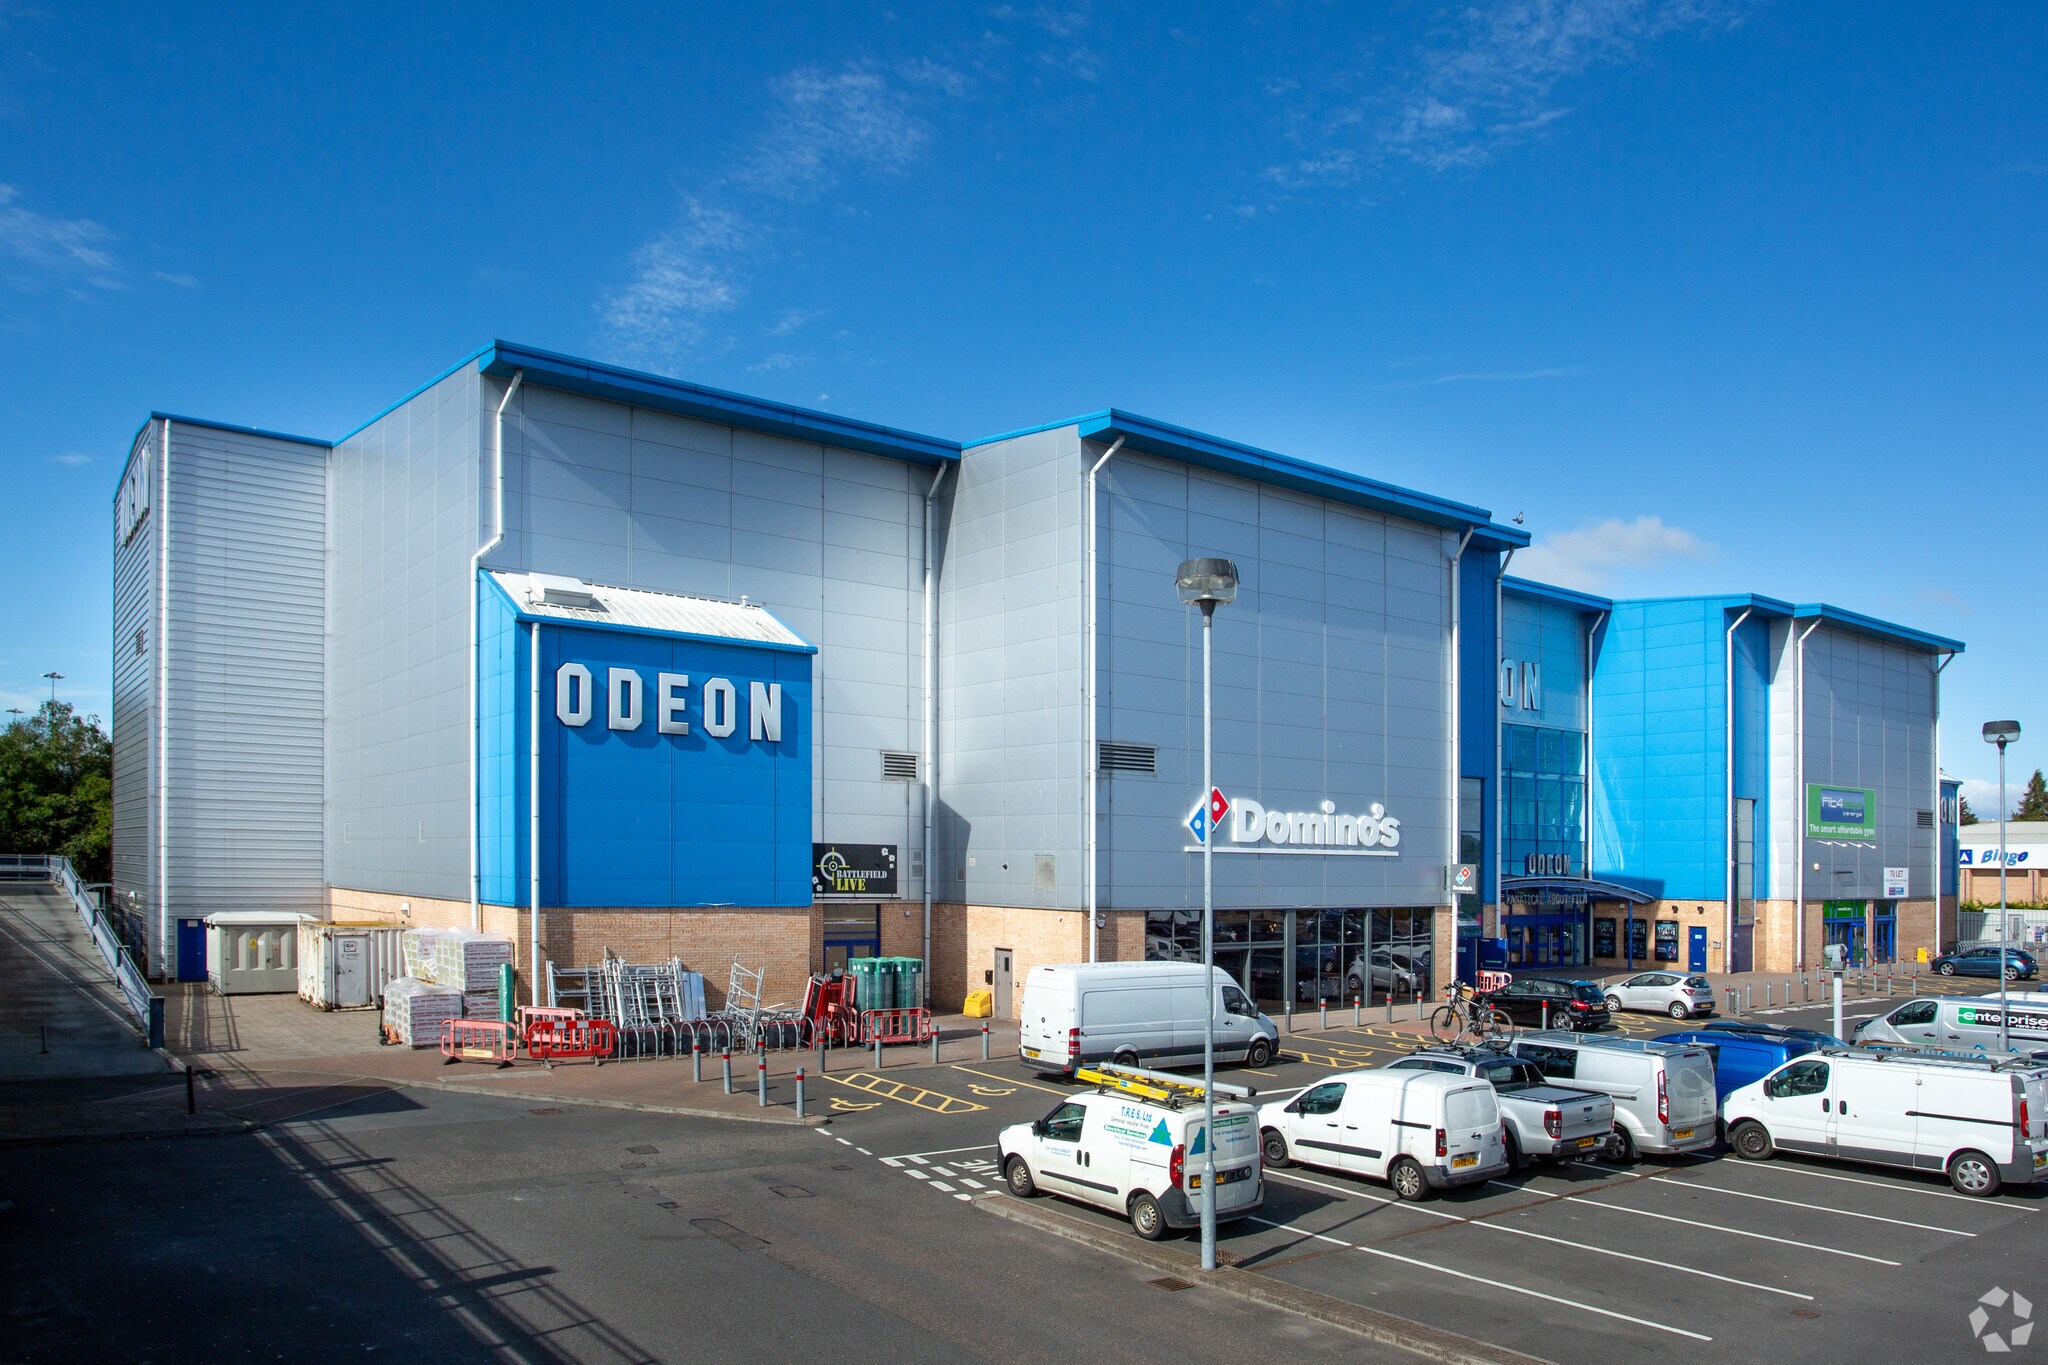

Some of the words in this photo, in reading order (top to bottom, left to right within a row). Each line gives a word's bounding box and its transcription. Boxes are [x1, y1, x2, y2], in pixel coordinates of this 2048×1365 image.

[556, 662, 782, 743] ODEON
[1232, 799, 1401, 848] Domino's
[1809, 824, 1820, 833] The
[1820, 825, 1836, 834] smart
[1837, 826, 1863, 835] affordable
[1529, 854, 1571, 875] ODEON
[836, 870, 888, 879] BATTLEFIELD
[836, 879, 866, 891] LIVE
[1507, 894, 1544, 905] FANATICAL
[1547, 894, 1569, 905] ABOUT
[1571, 894, 1588, 904] FILM
